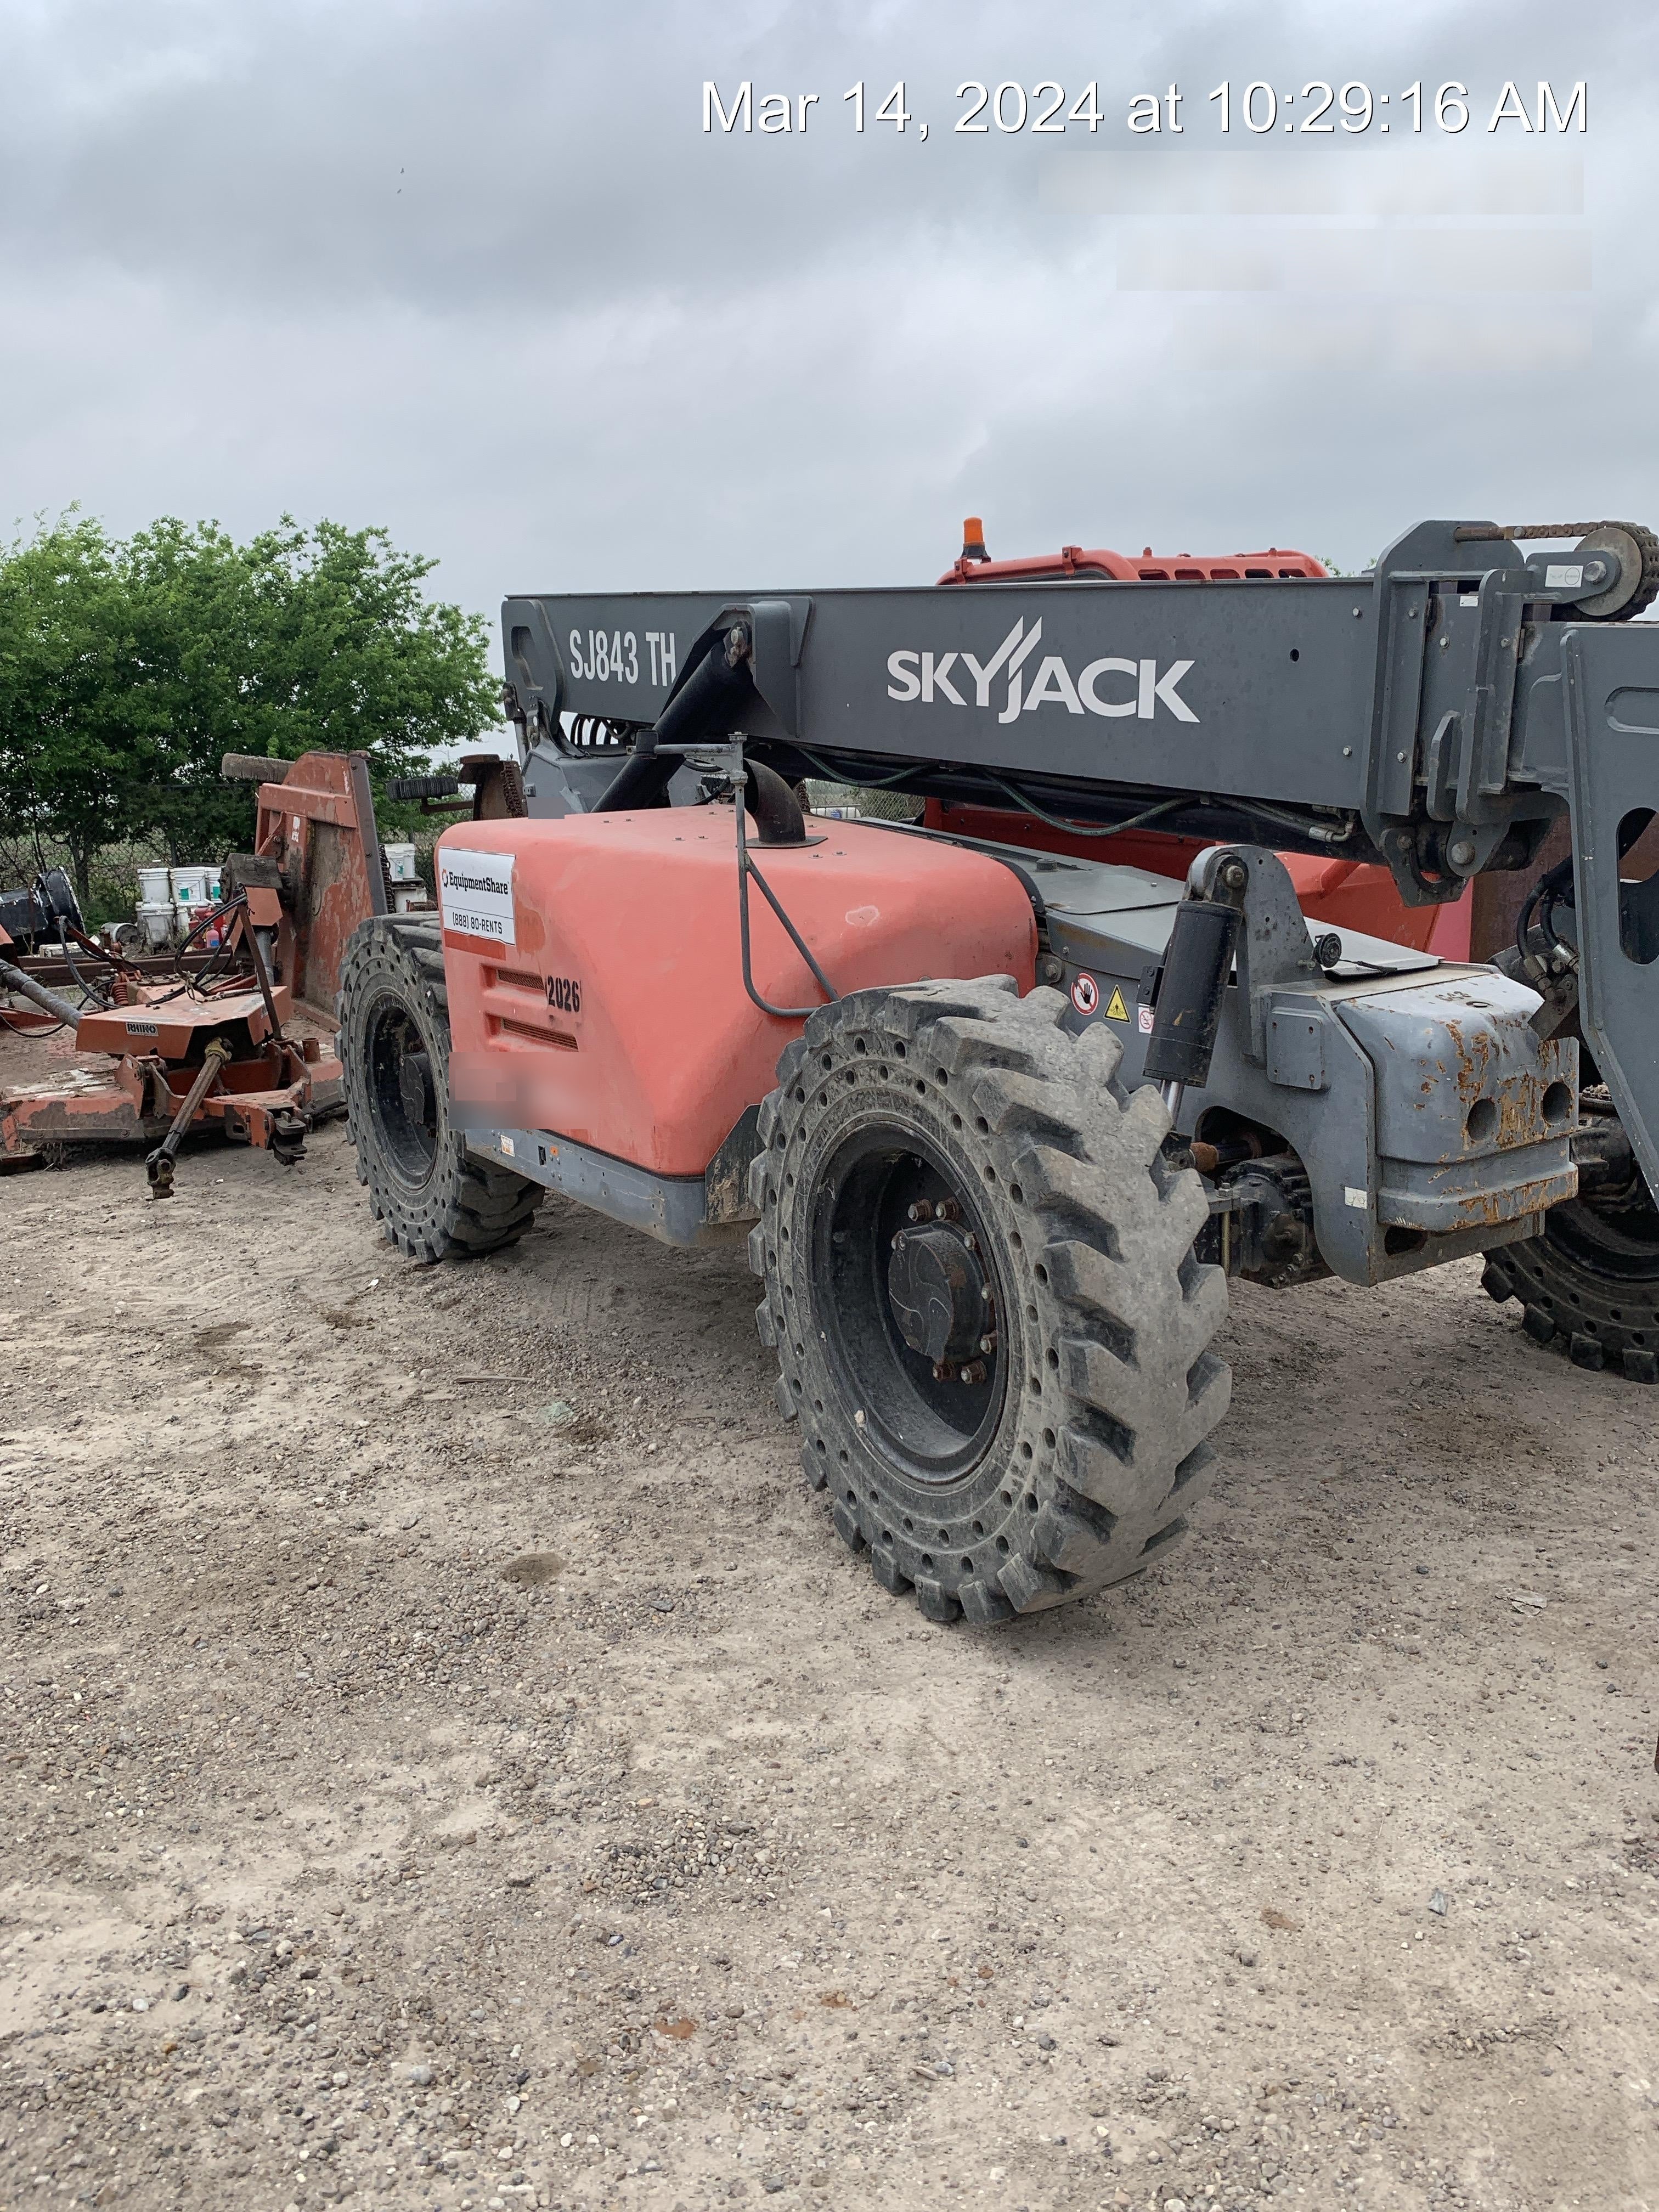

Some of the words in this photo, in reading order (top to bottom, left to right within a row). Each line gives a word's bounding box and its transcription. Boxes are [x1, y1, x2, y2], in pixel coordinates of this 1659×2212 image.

[569, 629, 639, 684] SJ843
[645, 631, 676, 687] TH
[887, 616, 1201, 724] SKYJACK
[449, 871, 509, 895] EquipmentShare
[453, 912, 469, 929] (888)
[471, 917, 503, 934] 80-RENTS
[548, 975, 580, 1013] 2026
[127, 1024, 156, 1033] RHINO
